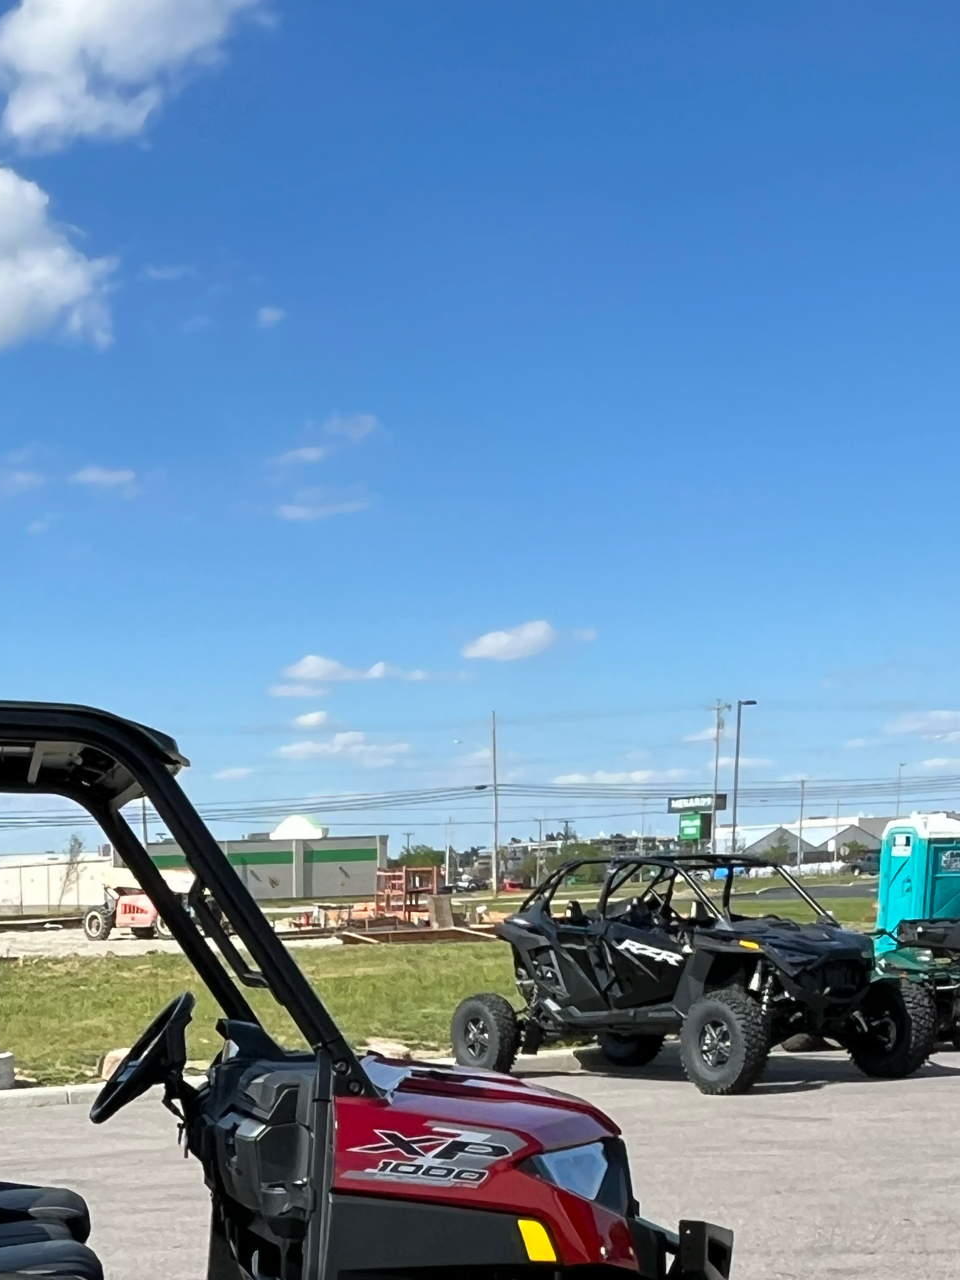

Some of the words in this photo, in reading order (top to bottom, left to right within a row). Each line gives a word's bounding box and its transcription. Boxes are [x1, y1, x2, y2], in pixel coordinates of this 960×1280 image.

[617, 939, 684, 967] RZR
[345, 1129, 513, 1161] XP
[378, 1159, 489, 1184] 1000
